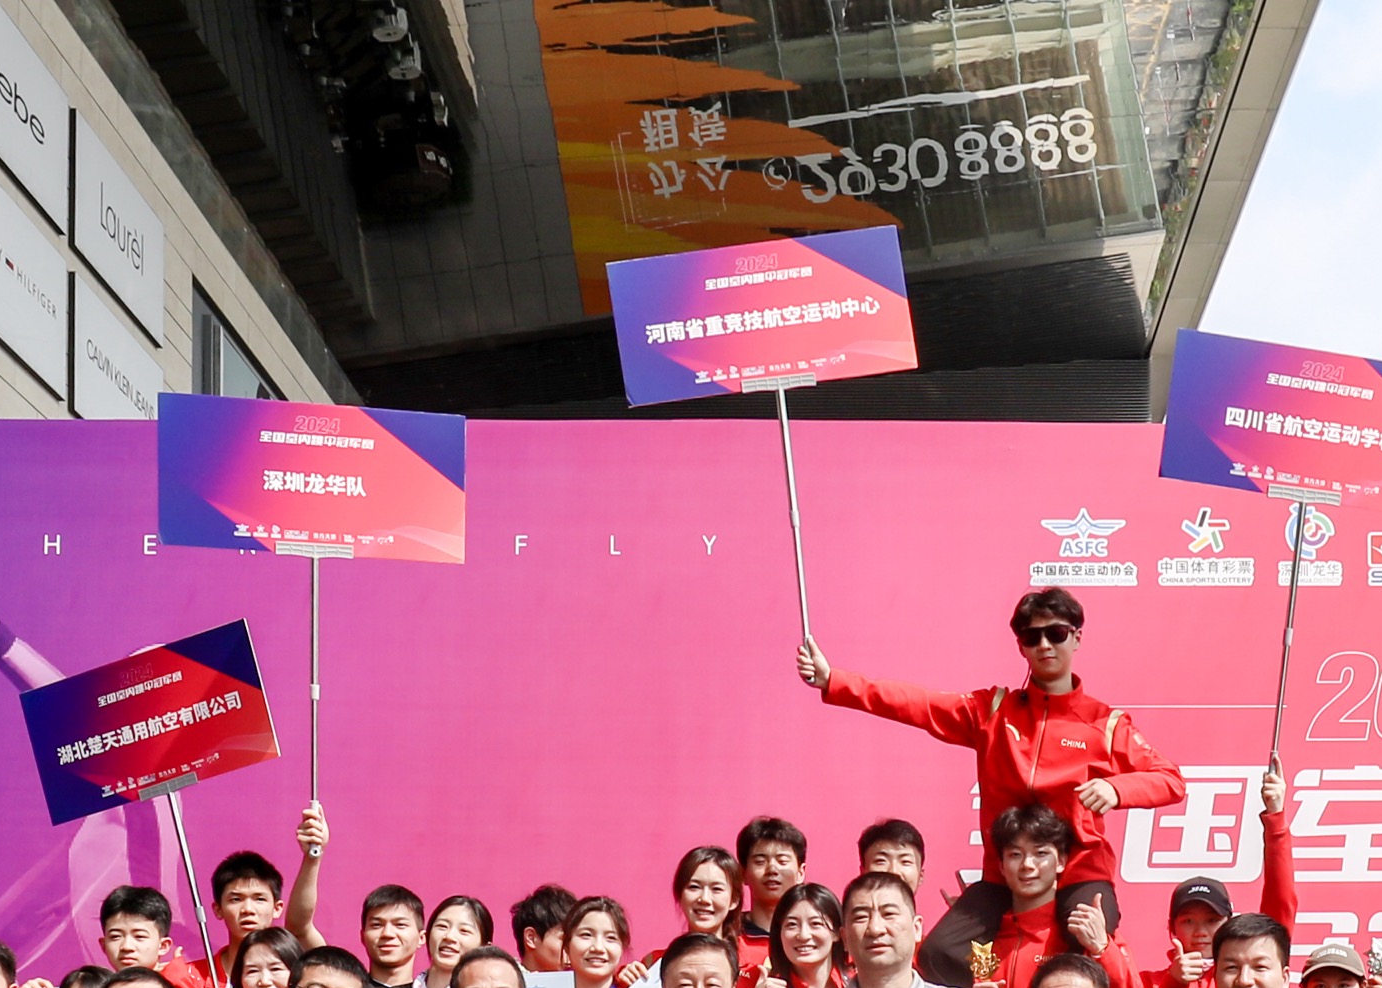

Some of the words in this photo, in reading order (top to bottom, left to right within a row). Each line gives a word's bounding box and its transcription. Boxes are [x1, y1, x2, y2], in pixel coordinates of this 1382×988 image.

[99, 181, 144, 276] Laurèl
[735, 254, 778, 273] 2024
[16, 268, 58, 320] HILFIGER
[645, 295, 881, 345] 河南省重竞技航空运动中心
[85, 339, 113, 380] CALVIN
[113, 368, 135, 400] KLEIN
[1299, 360, 1345, 382] 2024
[294, 415, 341, 435] 2024
[262, 469, 367, 497] 深圳龙华队
[1062, 540, 1106, 555] ASFC
[1032, 564, 1135, 577] 中国航空运动协会
[1160, 560, 1252, 574] 中国体育彩票
[1280, 563, 1340, 577] 深圳龙华
[56, 690, 243, 765] 湖北楚天通用航空有限公司
[1060, 738, 1087, 750] CHINA
